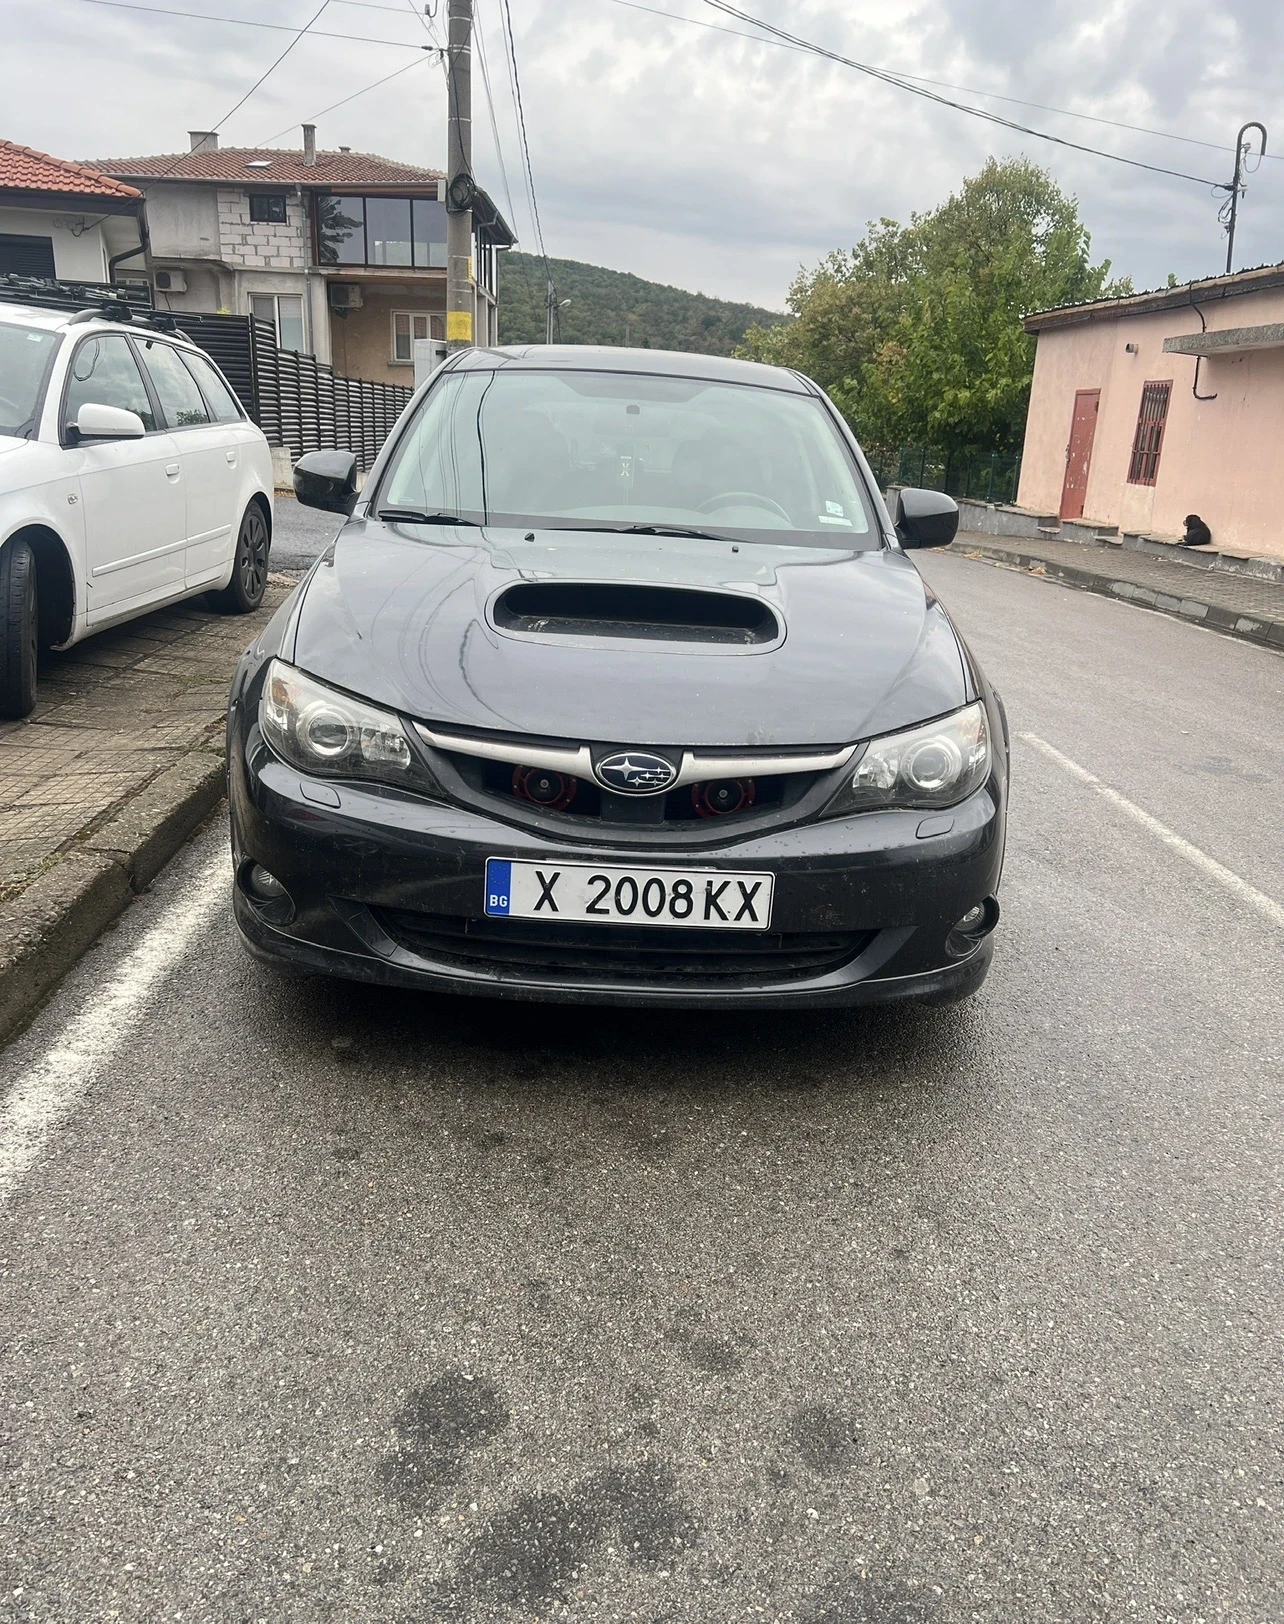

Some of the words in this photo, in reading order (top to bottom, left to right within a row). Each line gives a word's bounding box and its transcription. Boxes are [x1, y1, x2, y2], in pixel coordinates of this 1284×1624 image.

[489, 894, 508, 908] BG
[533, 870, 561, 912] X
[585, 875, 694, 919] 2008
[703, 880, 763, 922] KX
